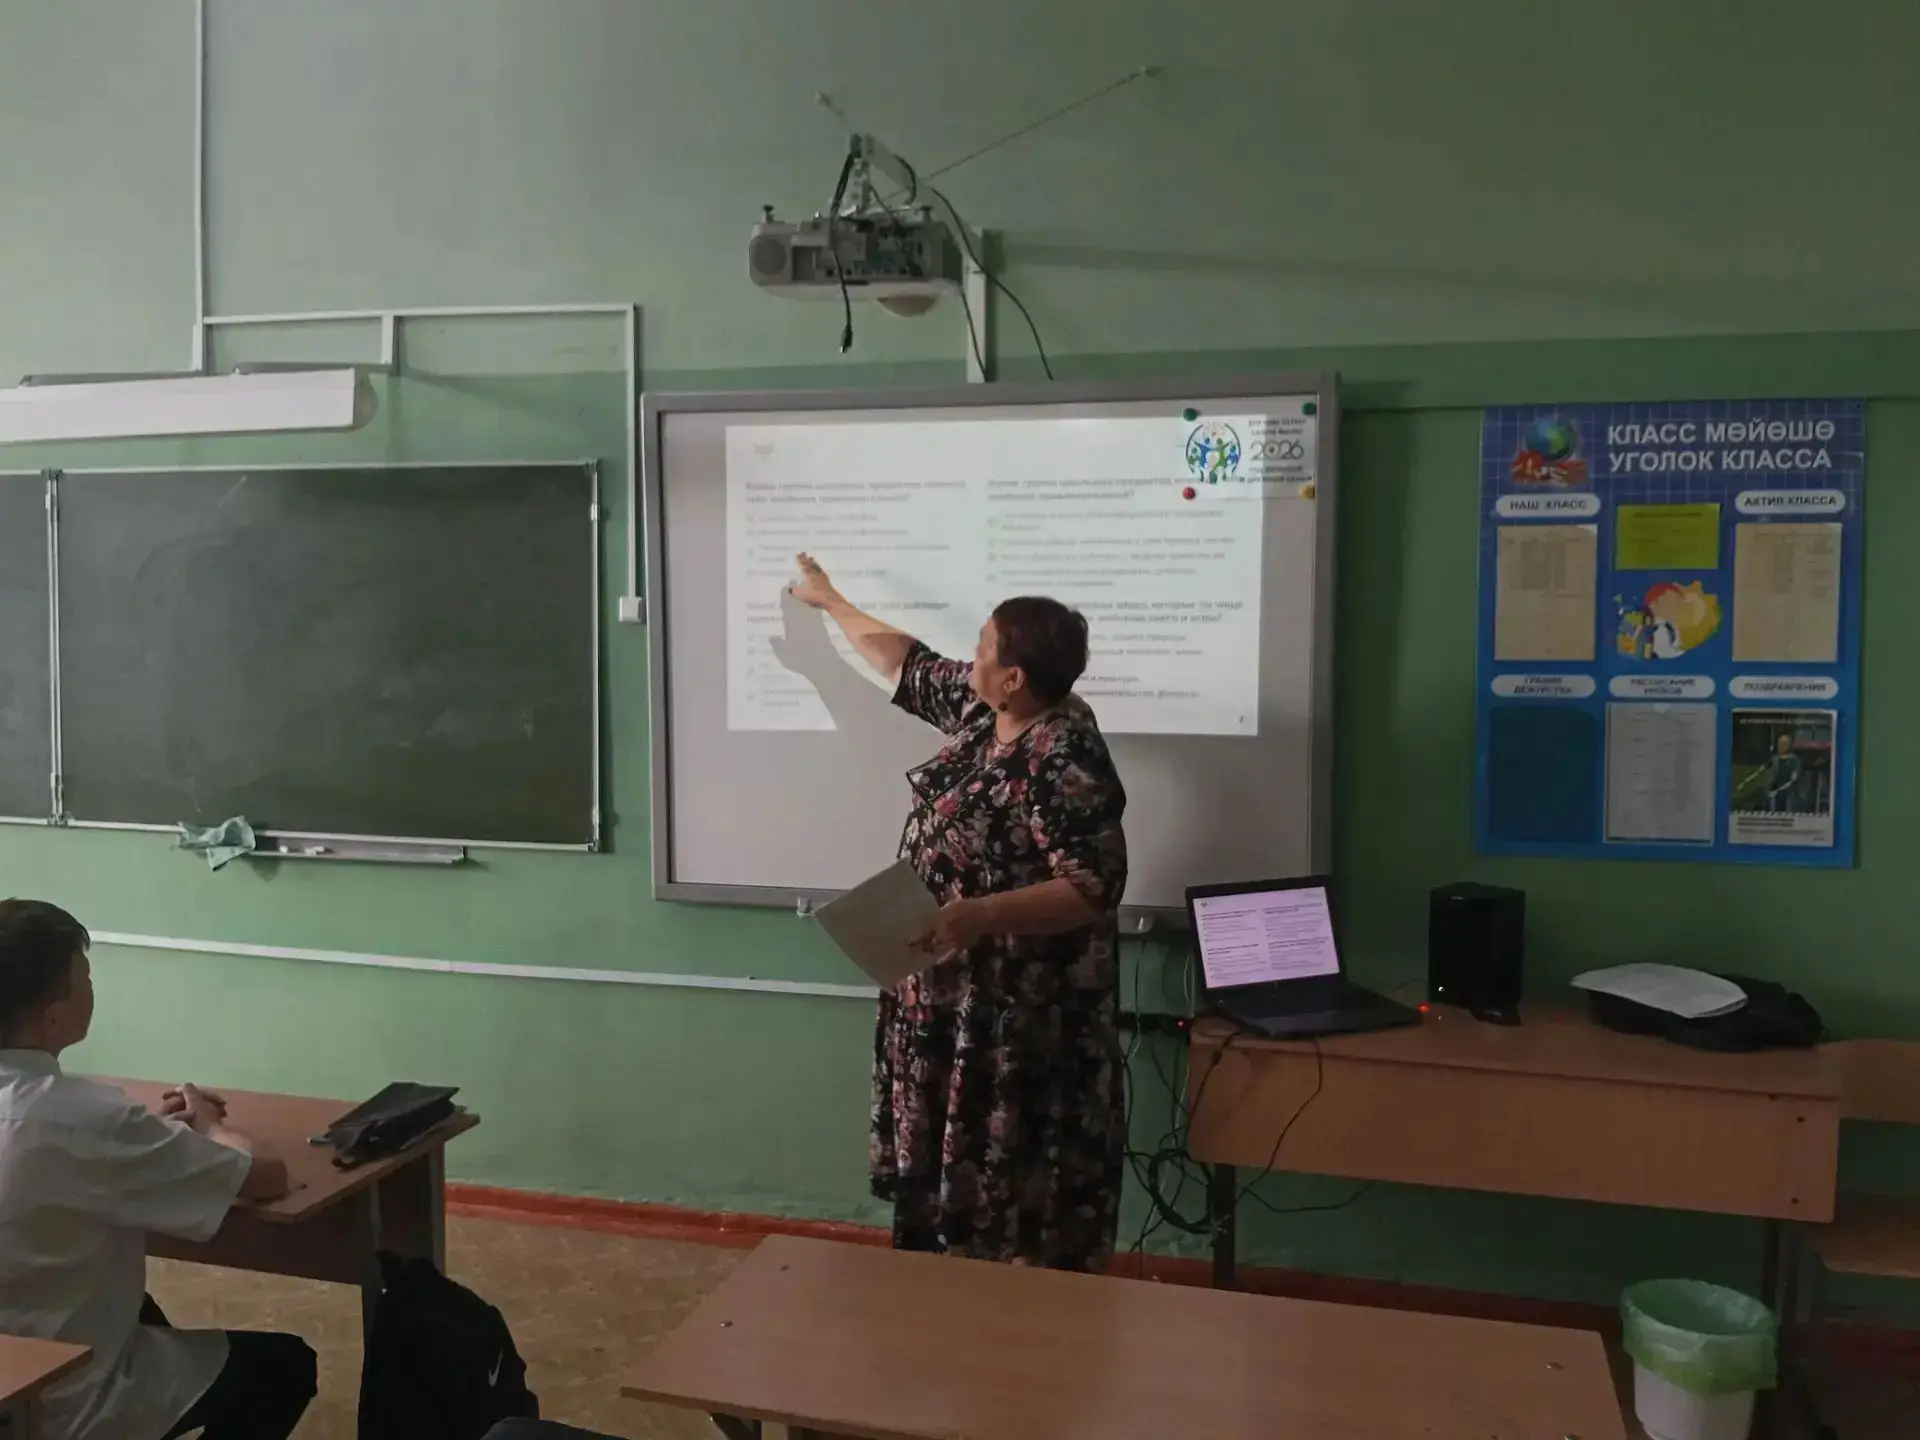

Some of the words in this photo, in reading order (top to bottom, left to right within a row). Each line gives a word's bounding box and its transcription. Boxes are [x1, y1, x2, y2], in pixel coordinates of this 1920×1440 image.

[1607, 423, 1697, 445] КЛАСС
[1705, 417, 1835, 443] МӨЙӨШӨ
[1250, 439, 1304, 461] 2026
[1609, 450, 1715, 473] УГОЛОК
[1721, 448, 1833, 470] КЛАССА
[1510, 500, 1539, 511] НАШ
[1546, 500, 1587, 511] КЛАСС
[1788, 495, 1837, 505] КЛАССА
